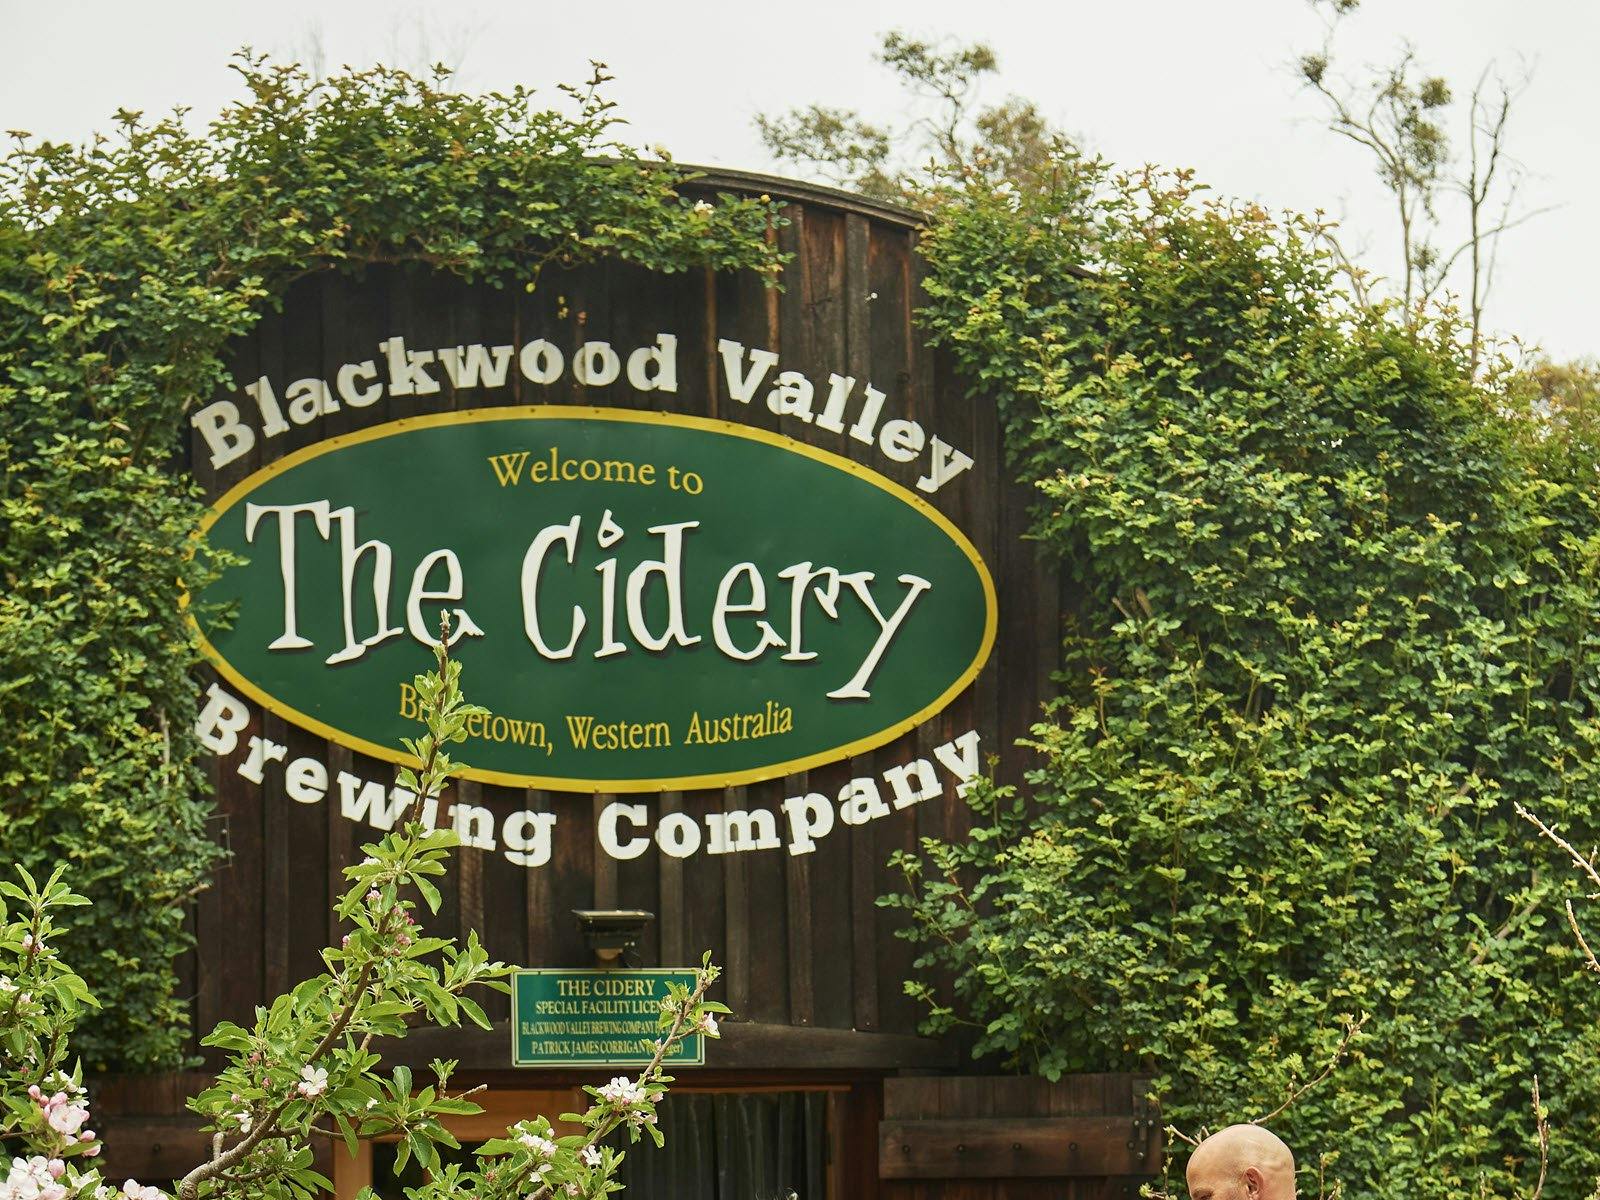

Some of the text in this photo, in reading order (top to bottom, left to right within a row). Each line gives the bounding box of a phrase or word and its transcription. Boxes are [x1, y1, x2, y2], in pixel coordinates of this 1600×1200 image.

[190, 333, 975, 494] Blackwood Valley
[488, 447, 704, 495] Welcome to
[245, 499, 932, 698] The Cidery
[566, 715, 672, 750] Western
[684, 700, 793, 745] Australia
[194, 682, 981, 867] Brewing Company
[535, 1000, 580, 1015] SPECIAL
[582, 1000, 631, 1014] FACILITY
[557, 979, 656, 996] THE CIDERY
[522, 1021, 565, 1035] BLACKWOOD
[565, 1021, 591, 1035] VALLEY
[591, 1021, 621, 1035] BREWING
[532, 1041, 570, 1055] PATRICK
[570, 1040, 600, 1057] JAMES
[600, 1040, 646, 1054] CORRIGAN
